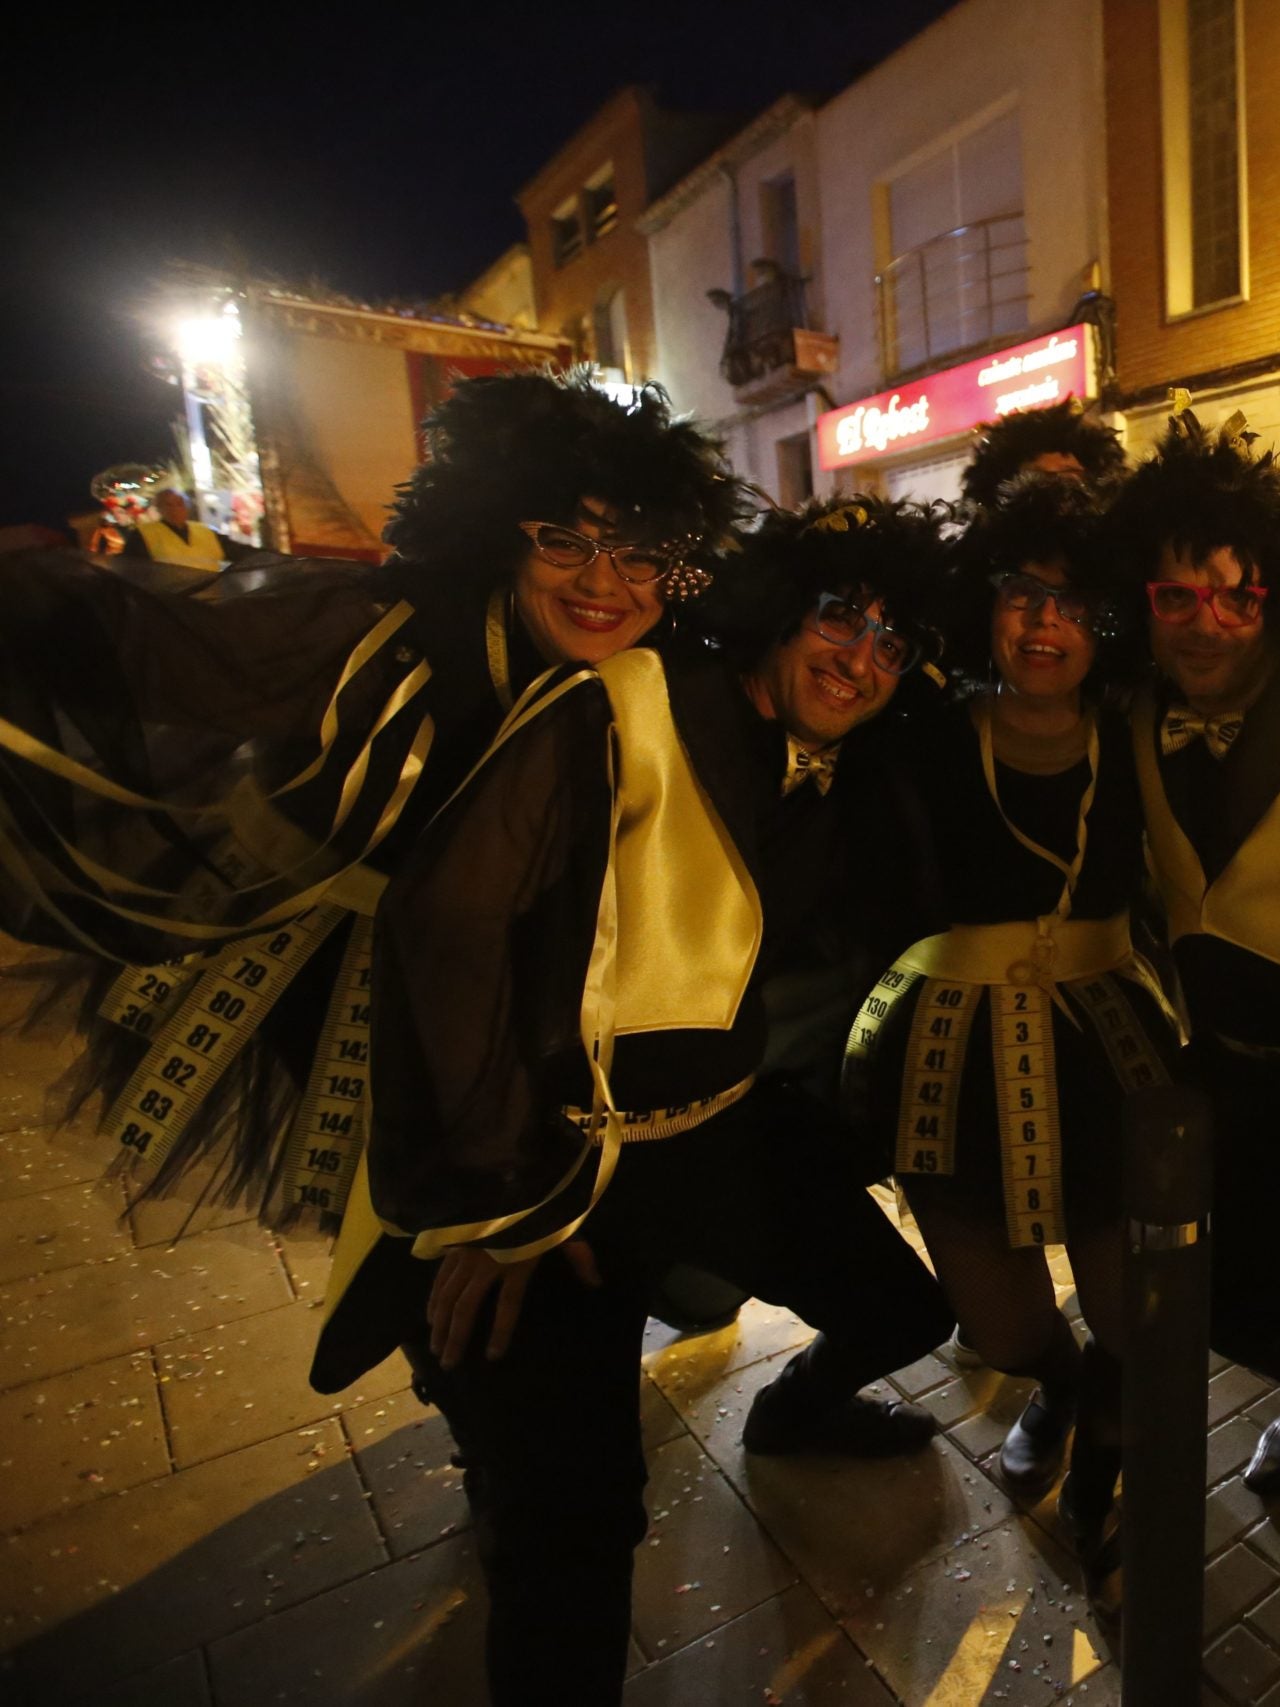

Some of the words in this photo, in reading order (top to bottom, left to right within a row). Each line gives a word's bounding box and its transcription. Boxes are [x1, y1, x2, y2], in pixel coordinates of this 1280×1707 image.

[232, 957, 268, 988] 79
[881, 970, 905, 989] 129
[138, 974, 171, 1002] 29
[935, 989, 963, 1007] 40
[208, 990, 246, 1022] 80
[866, 996, 888, 1018] 130
[1014, 993, 1028, 1011] 2
[119, 1004, 152, 1034] 30
[929, 1017, 953, 1038] 41
[186, 1024, 222, 1055] 81
[1015, 1021, 1029, 1043] 3
[161, 1056, 197, 1089] 82
[1017, 1054, 1031, 1076] 4
[328, 1075, 365, 1099] 143
[1020, 1087, 1034, 1110] 5
[138, 1089, 175, 1122] 83
[318, 1111, 353, 1135] 144
[914, 1115, 939, 1138] 44
[1022, 1120, 1036, 1143] 6
[119, 1123, 154, 1154] 84
[305, 1148, 342, 1173] 145
[912, 1150, 938, 1173] 45
[1025, 1154, 1037, 1177] 7
[299, 1185, 330, 1208] 146
[1026, 1188, 1041, 1211] 8
[1030, 1222, 1045, 1244] 9
